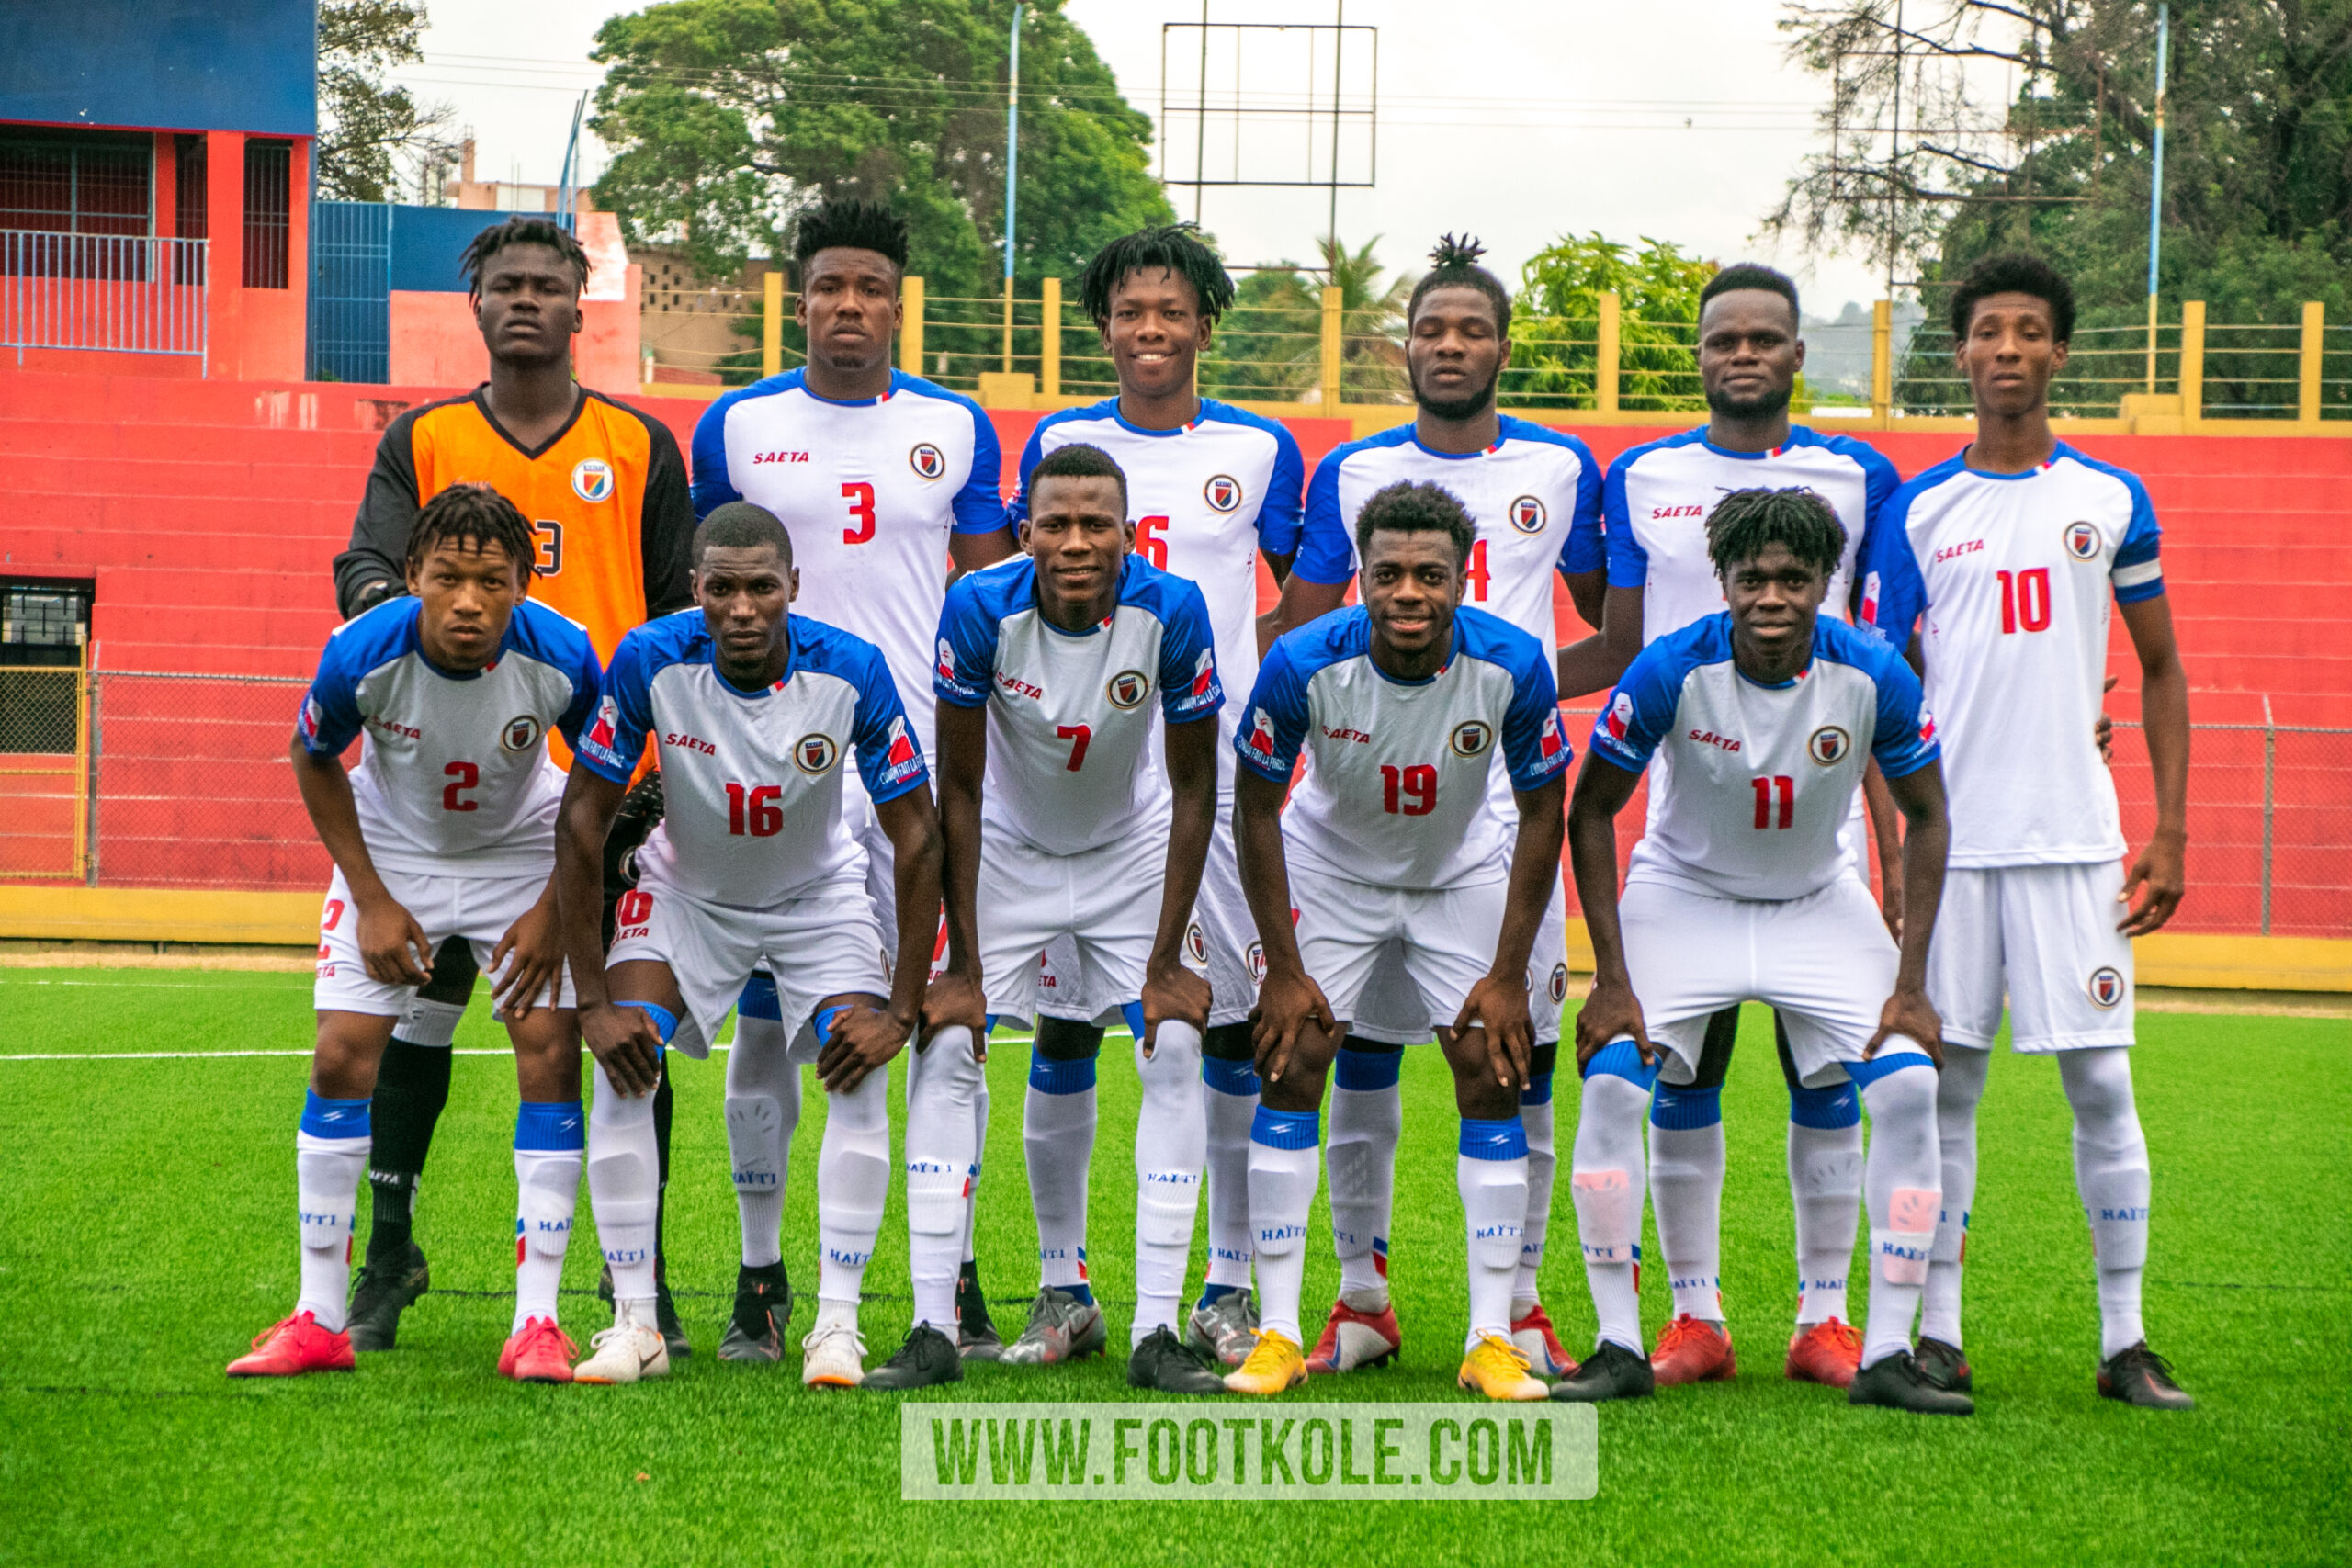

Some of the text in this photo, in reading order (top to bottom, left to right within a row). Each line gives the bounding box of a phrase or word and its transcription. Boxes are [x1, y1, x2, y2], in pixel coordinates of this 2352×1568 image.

[753, 451, 810, 465] SAETA
[842, 482, 876, 545] 3
[1652, 505, 1702, 520] SAETA
[1937, 539, 1984, 563] SAETA
[1996, 567, 2052, 635] 10
[996, 671, 1044, 701] SAETA
[665, 732, 717, 757] SAETA
[1057, 724, 1091, 773] 7
[1322, 725, 1371, 745] SAETA
[1689, 728, 1742, 753] SAETA
[443, 761, 479, 812] 2
[1380, 763, 1438, 816] 19
[1751, 775, 1794, 829] 11
[725, 782, 784, 838] 16
